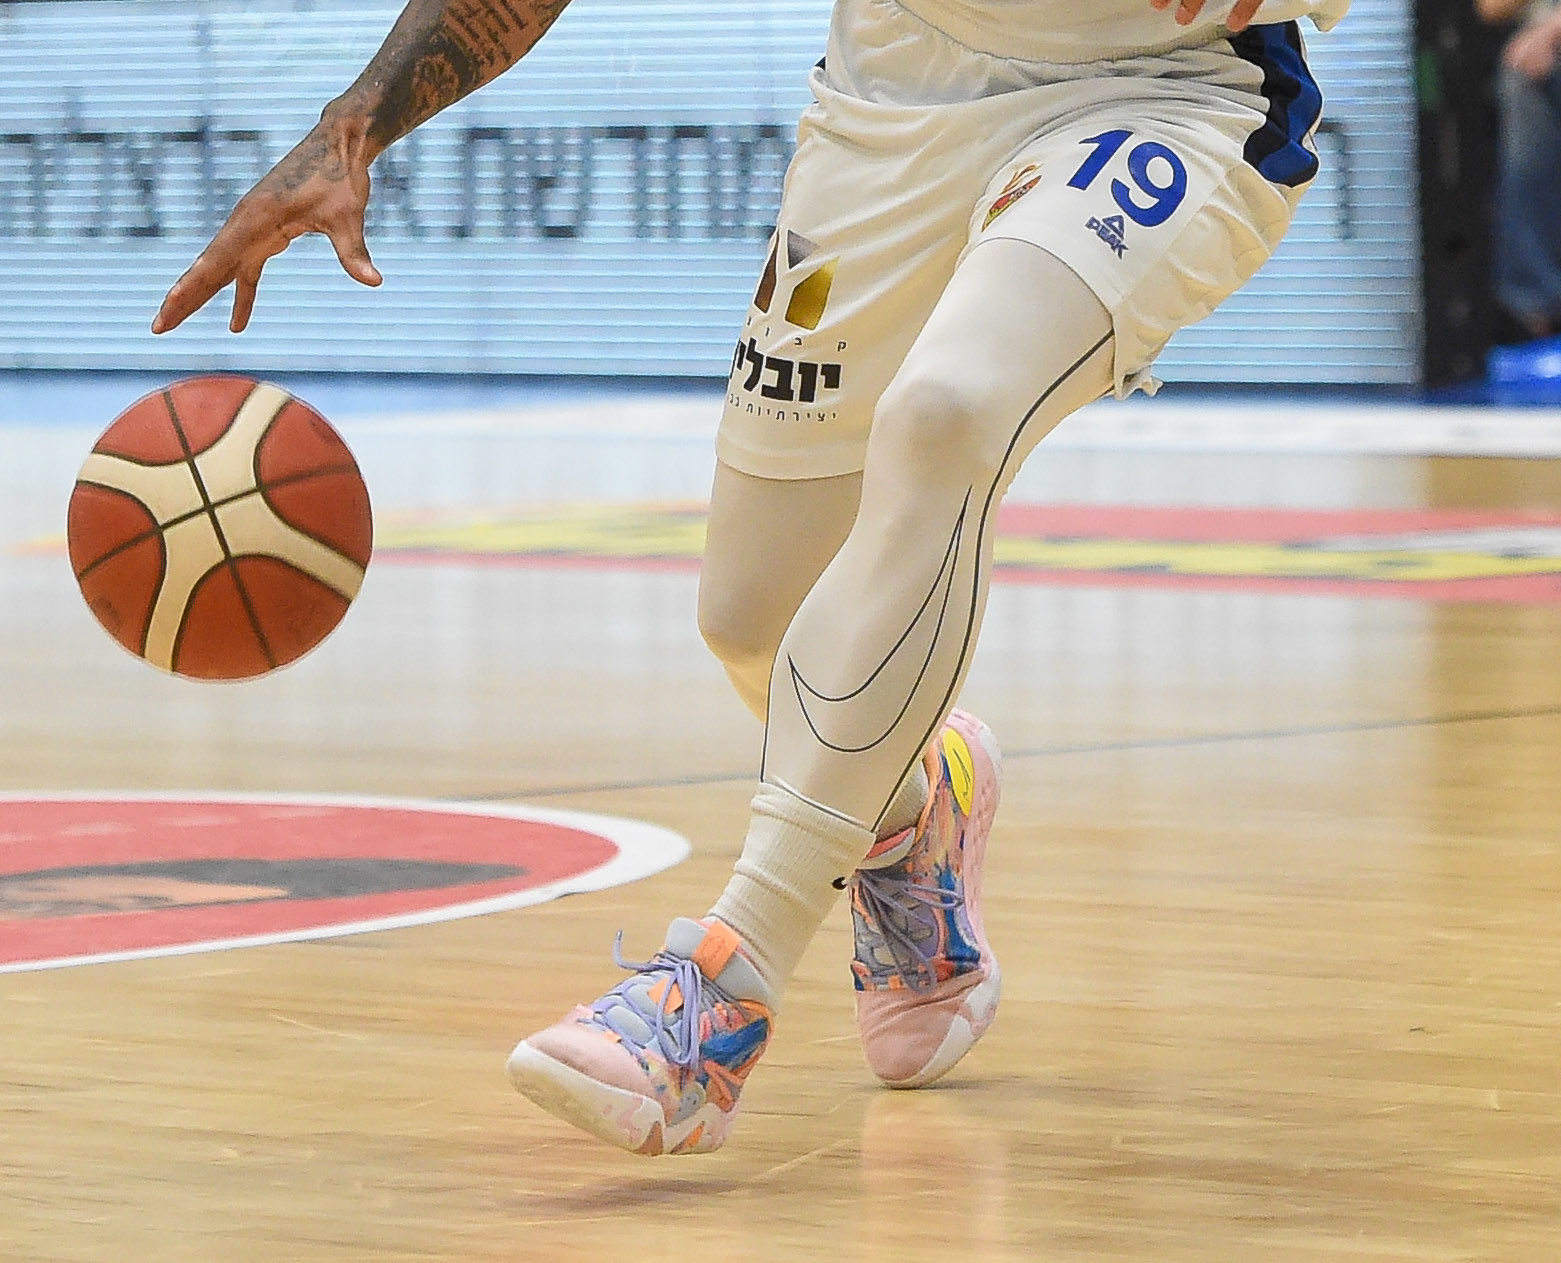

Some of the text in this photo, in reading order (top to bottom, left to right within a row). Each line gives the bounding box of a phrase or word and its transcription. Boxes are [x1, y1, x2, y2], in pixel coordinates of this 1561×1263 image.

[1066, 129, 1188, 228] 19
[1085, 216, 1129, 260] PEAK
[729, 337, 842, 403] יובלי
